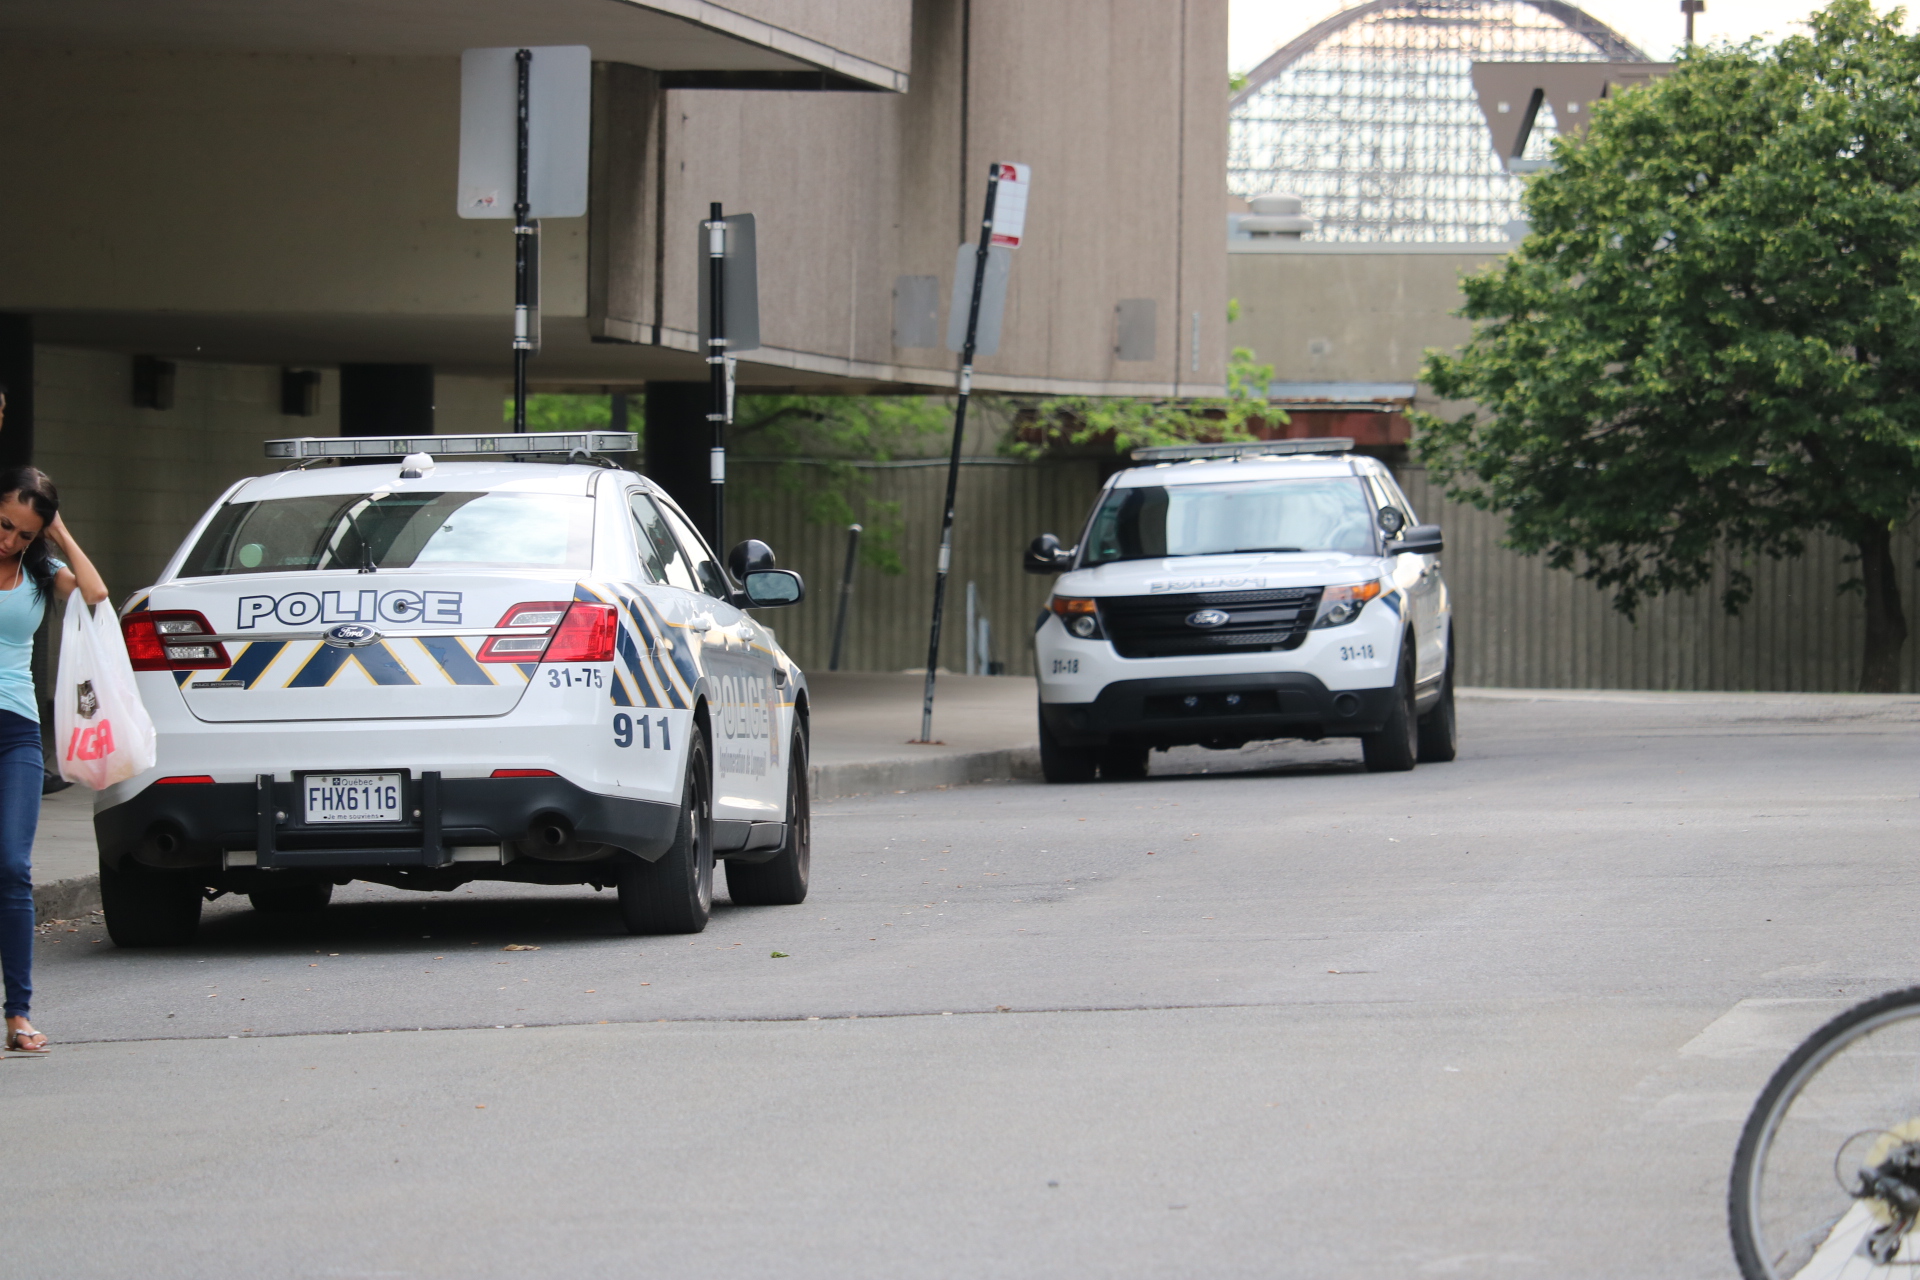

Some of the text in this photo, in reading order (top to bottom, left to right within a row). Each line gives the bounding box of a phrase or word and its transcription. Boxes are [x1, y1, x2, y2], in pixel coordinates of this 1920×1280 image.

[237, 589, 463, 629] POLICE
[338, 626, 364, 639] Ford
[1340, 644, 1374, 661] 31-18
[1052, 659, 1079, 674] 31-18
[547, 668, 603, 688] 31-75
[710, 675, 769, 740] POLICE
[66, 718, 115, 761] IGA
[613, 712, 671, 750] 911
[341, 778, 374, 786] Québec
[309, 786, 396, 811] FHX6116
